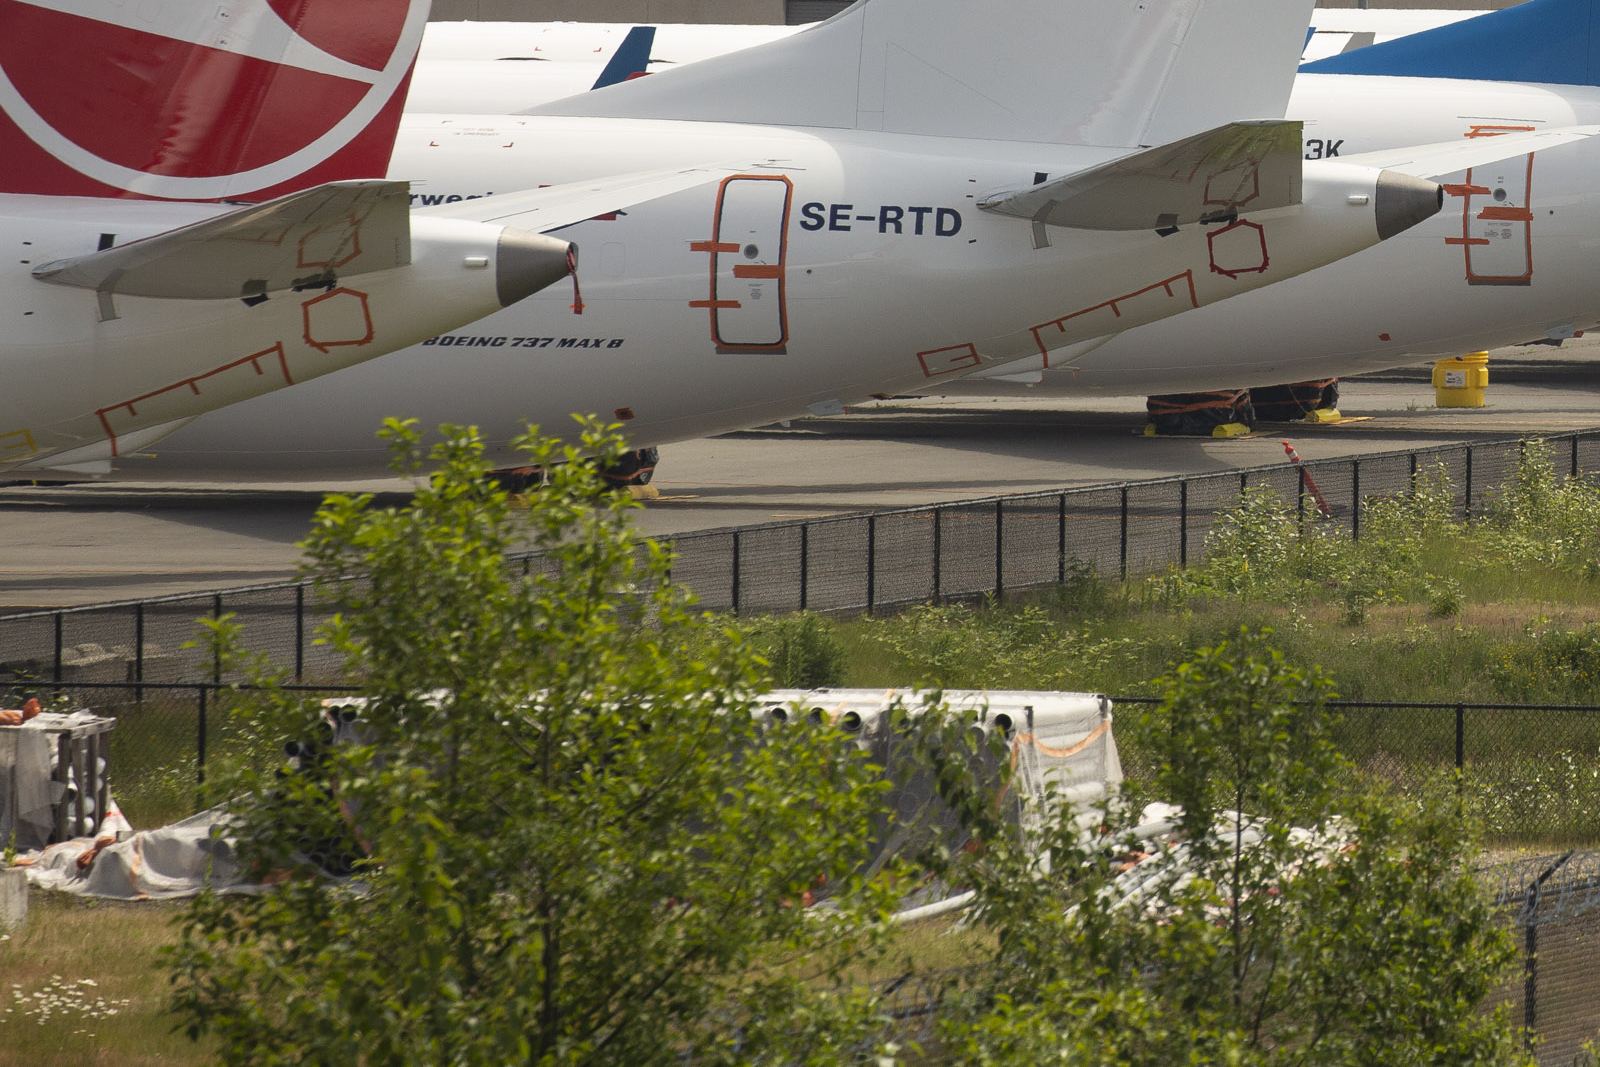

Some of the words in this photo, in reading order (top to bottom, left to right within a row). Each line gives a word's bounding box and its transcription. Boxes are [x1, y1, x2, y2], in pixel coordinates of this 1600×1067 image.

[800, 202, 962, 237] SE-RTD
[422, 336, 507, 347] BOEING
[510, 337, 554, 348] 737
[556, 338, 605, 348] MAX
[606, 339, 624, 348] 8
